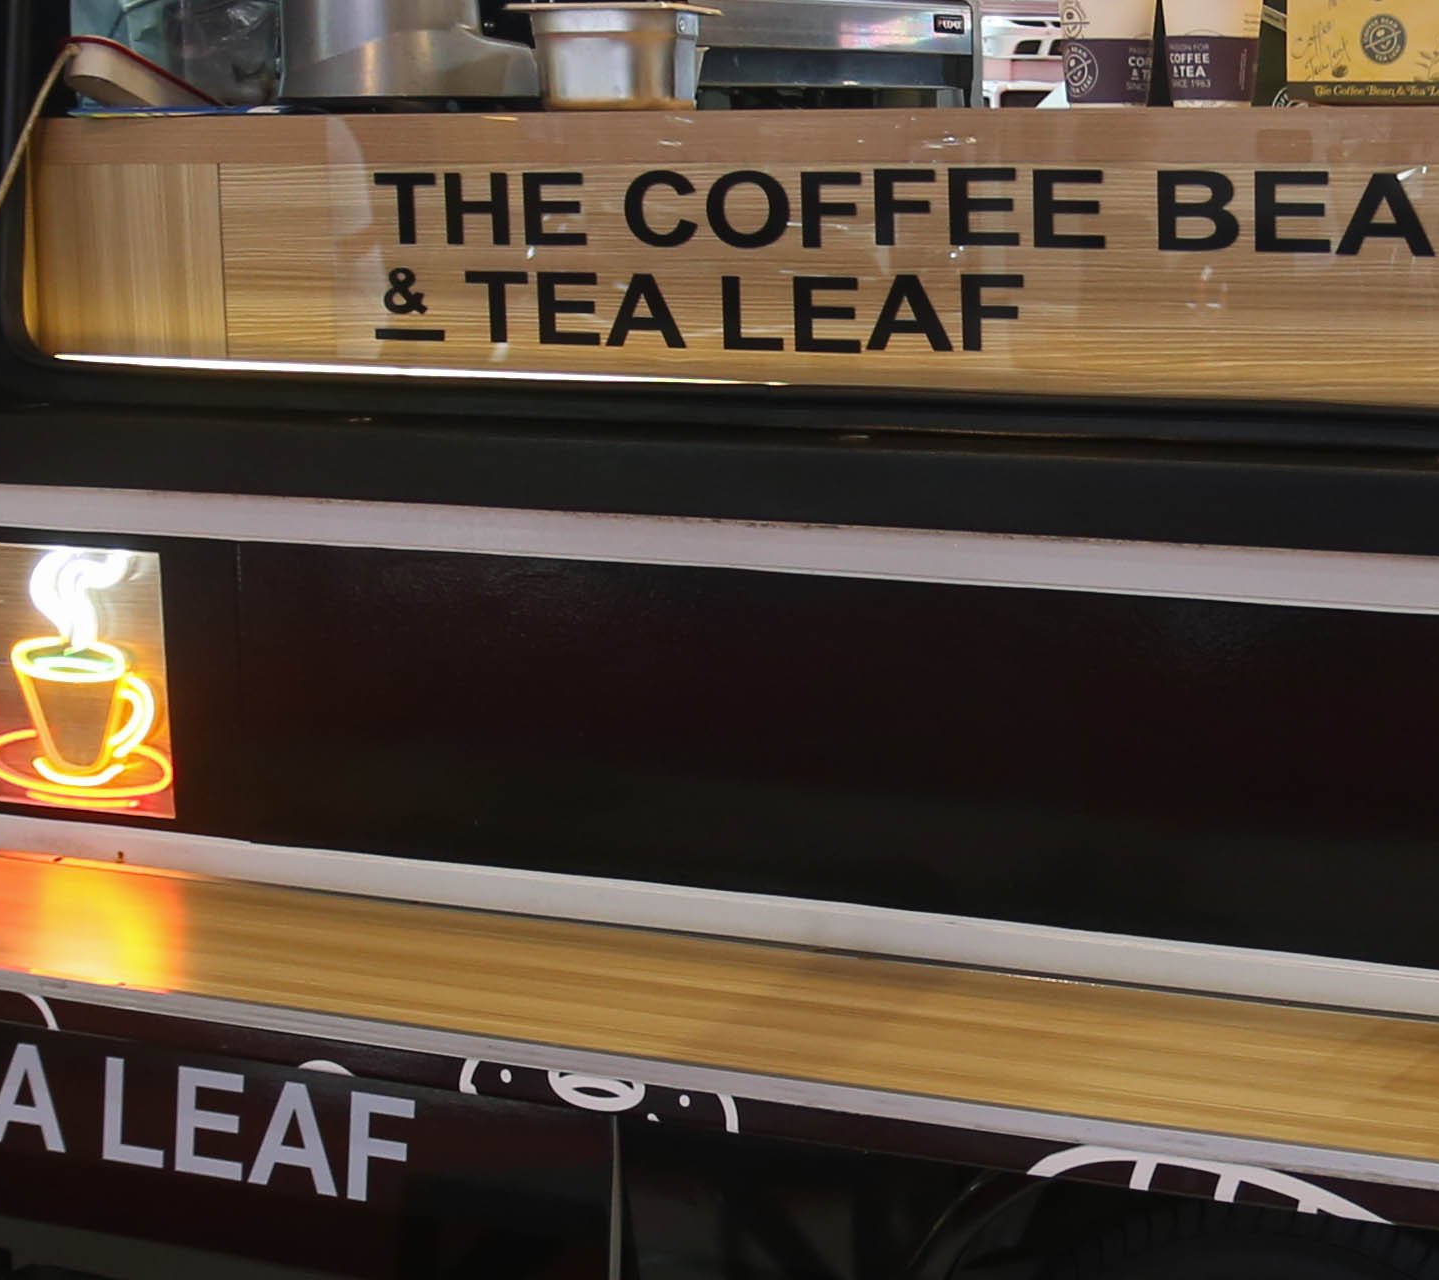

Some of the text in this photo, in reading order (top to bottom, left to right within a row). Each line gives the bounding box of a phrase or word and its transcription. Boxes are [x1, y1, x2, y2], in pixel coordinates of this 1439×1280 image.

[1169, 53, 1210, 64] COFFEE
[1179, 66, 1207, 78] TEA
[375, 171, 587, 248] THE
[624, 167, 1106, 250] COFFEE
[465, 269, 688, 350] TEA
[720, 273, 1025, 355] LEAF
[102, 1056, 416, 1202] LEAF
